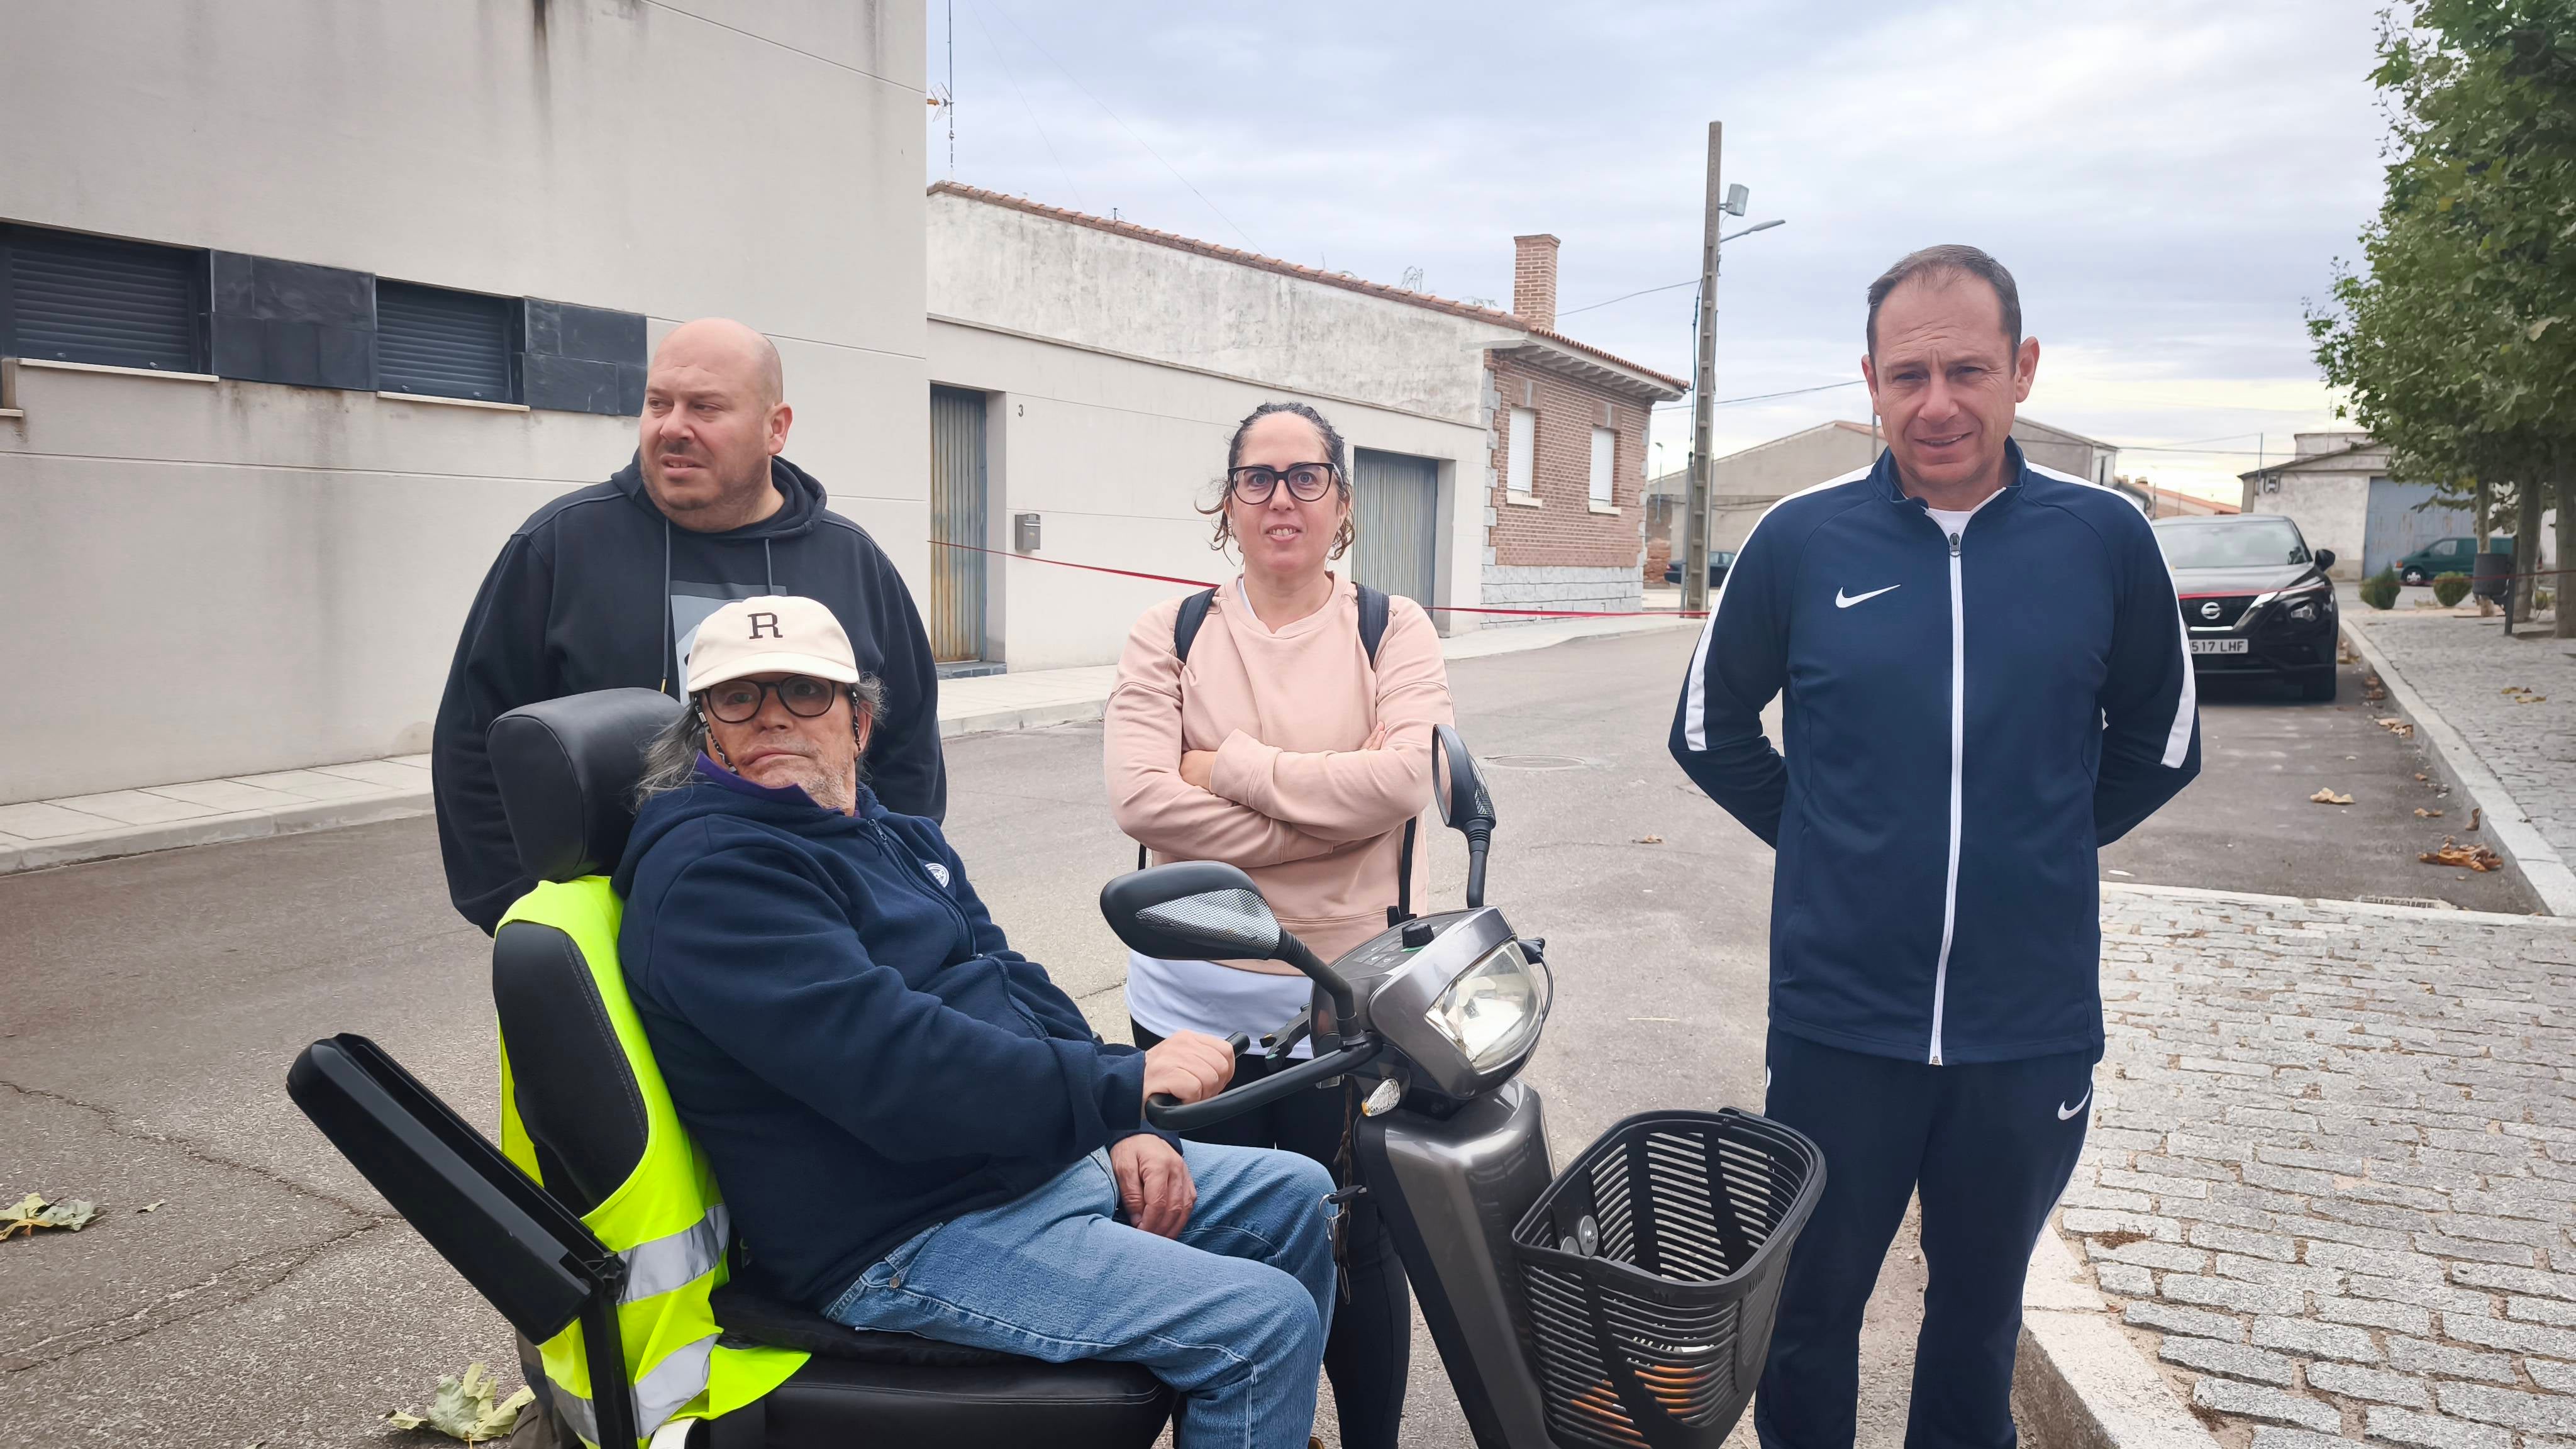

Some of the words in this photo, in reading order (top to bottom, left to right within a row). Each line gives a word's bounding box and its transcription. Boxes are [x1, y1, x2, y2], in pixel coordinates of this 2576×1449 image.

[1018, 404, 1024, 418] 3
[747, 612, 783, 640] R
[2189, 641, 2216, 652] 517
[2220, 640, 2245, 652] LHF
